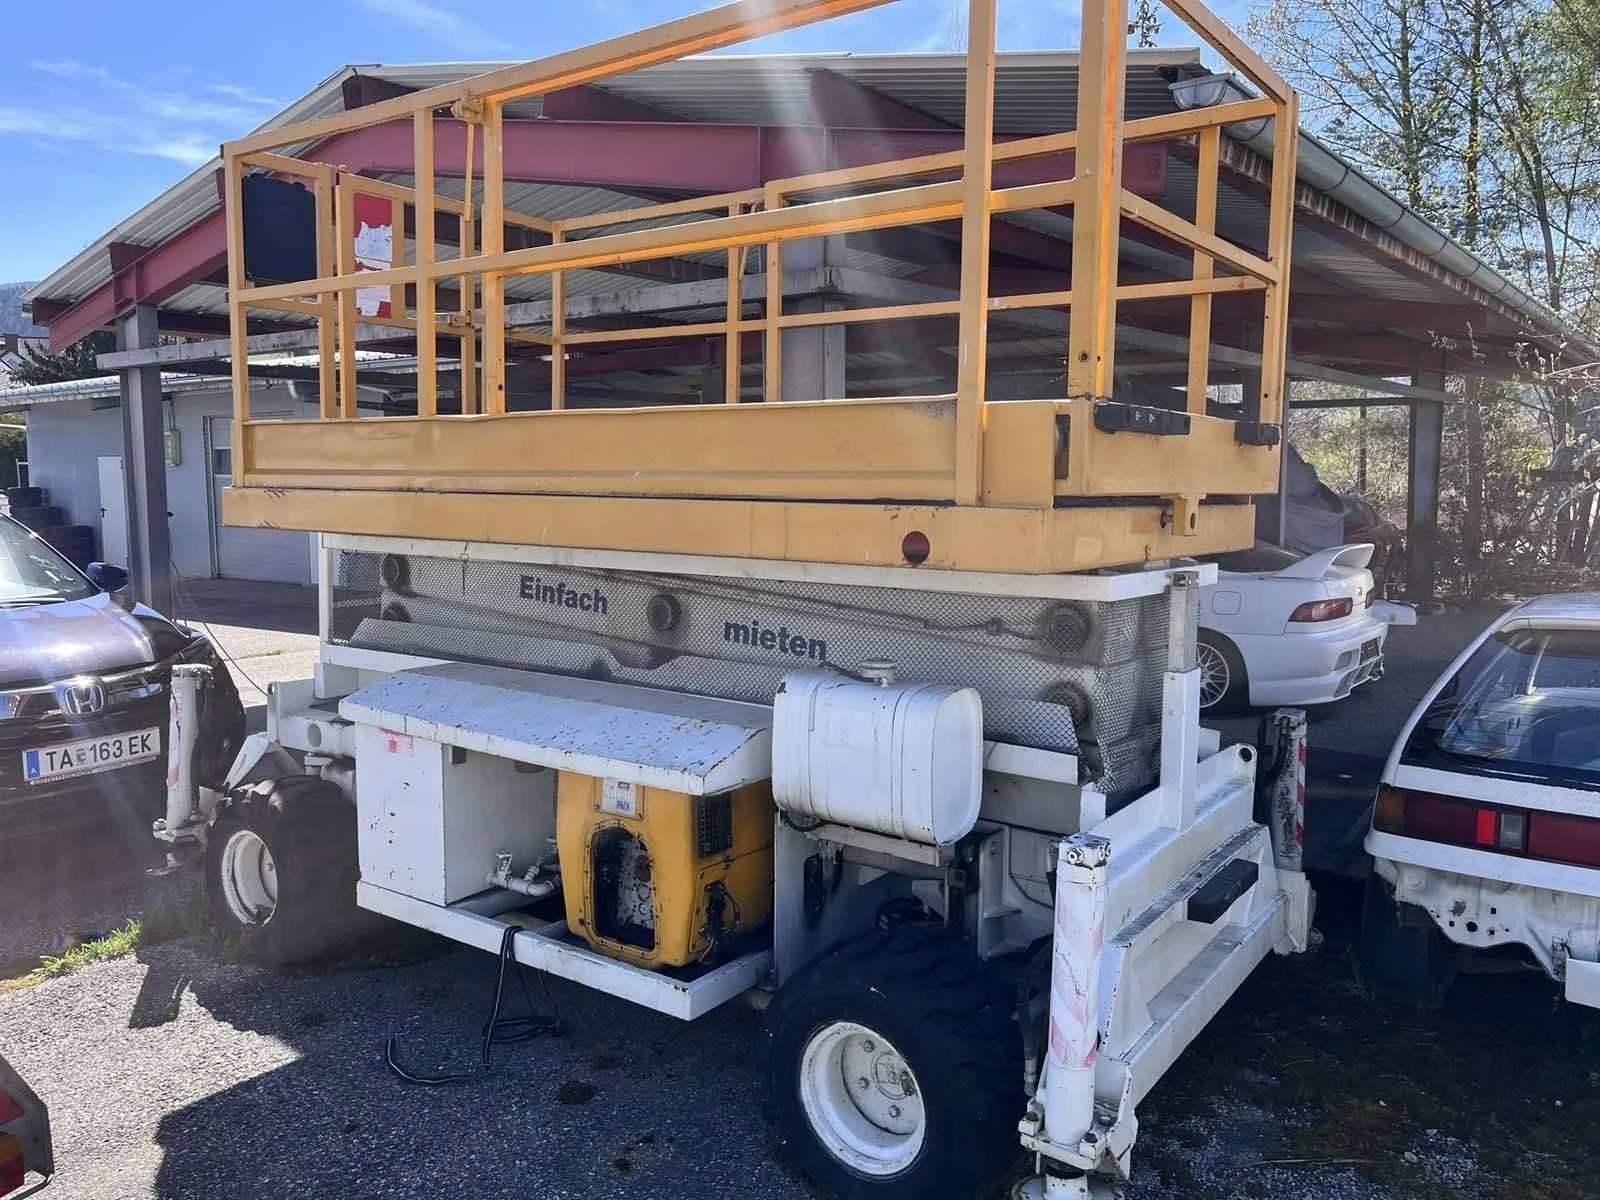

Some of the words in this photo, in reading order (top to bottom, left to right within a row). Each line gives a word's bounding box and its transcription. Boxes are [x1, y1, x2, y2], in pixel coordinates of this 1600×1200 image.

[519, 574, 608, 614] Einfach
[724, 620, 827, 661] mieten
[45, 750, 74, 772] TA
[89, 740, 123, 763] 163
[129, 733, 152, 756] EK
